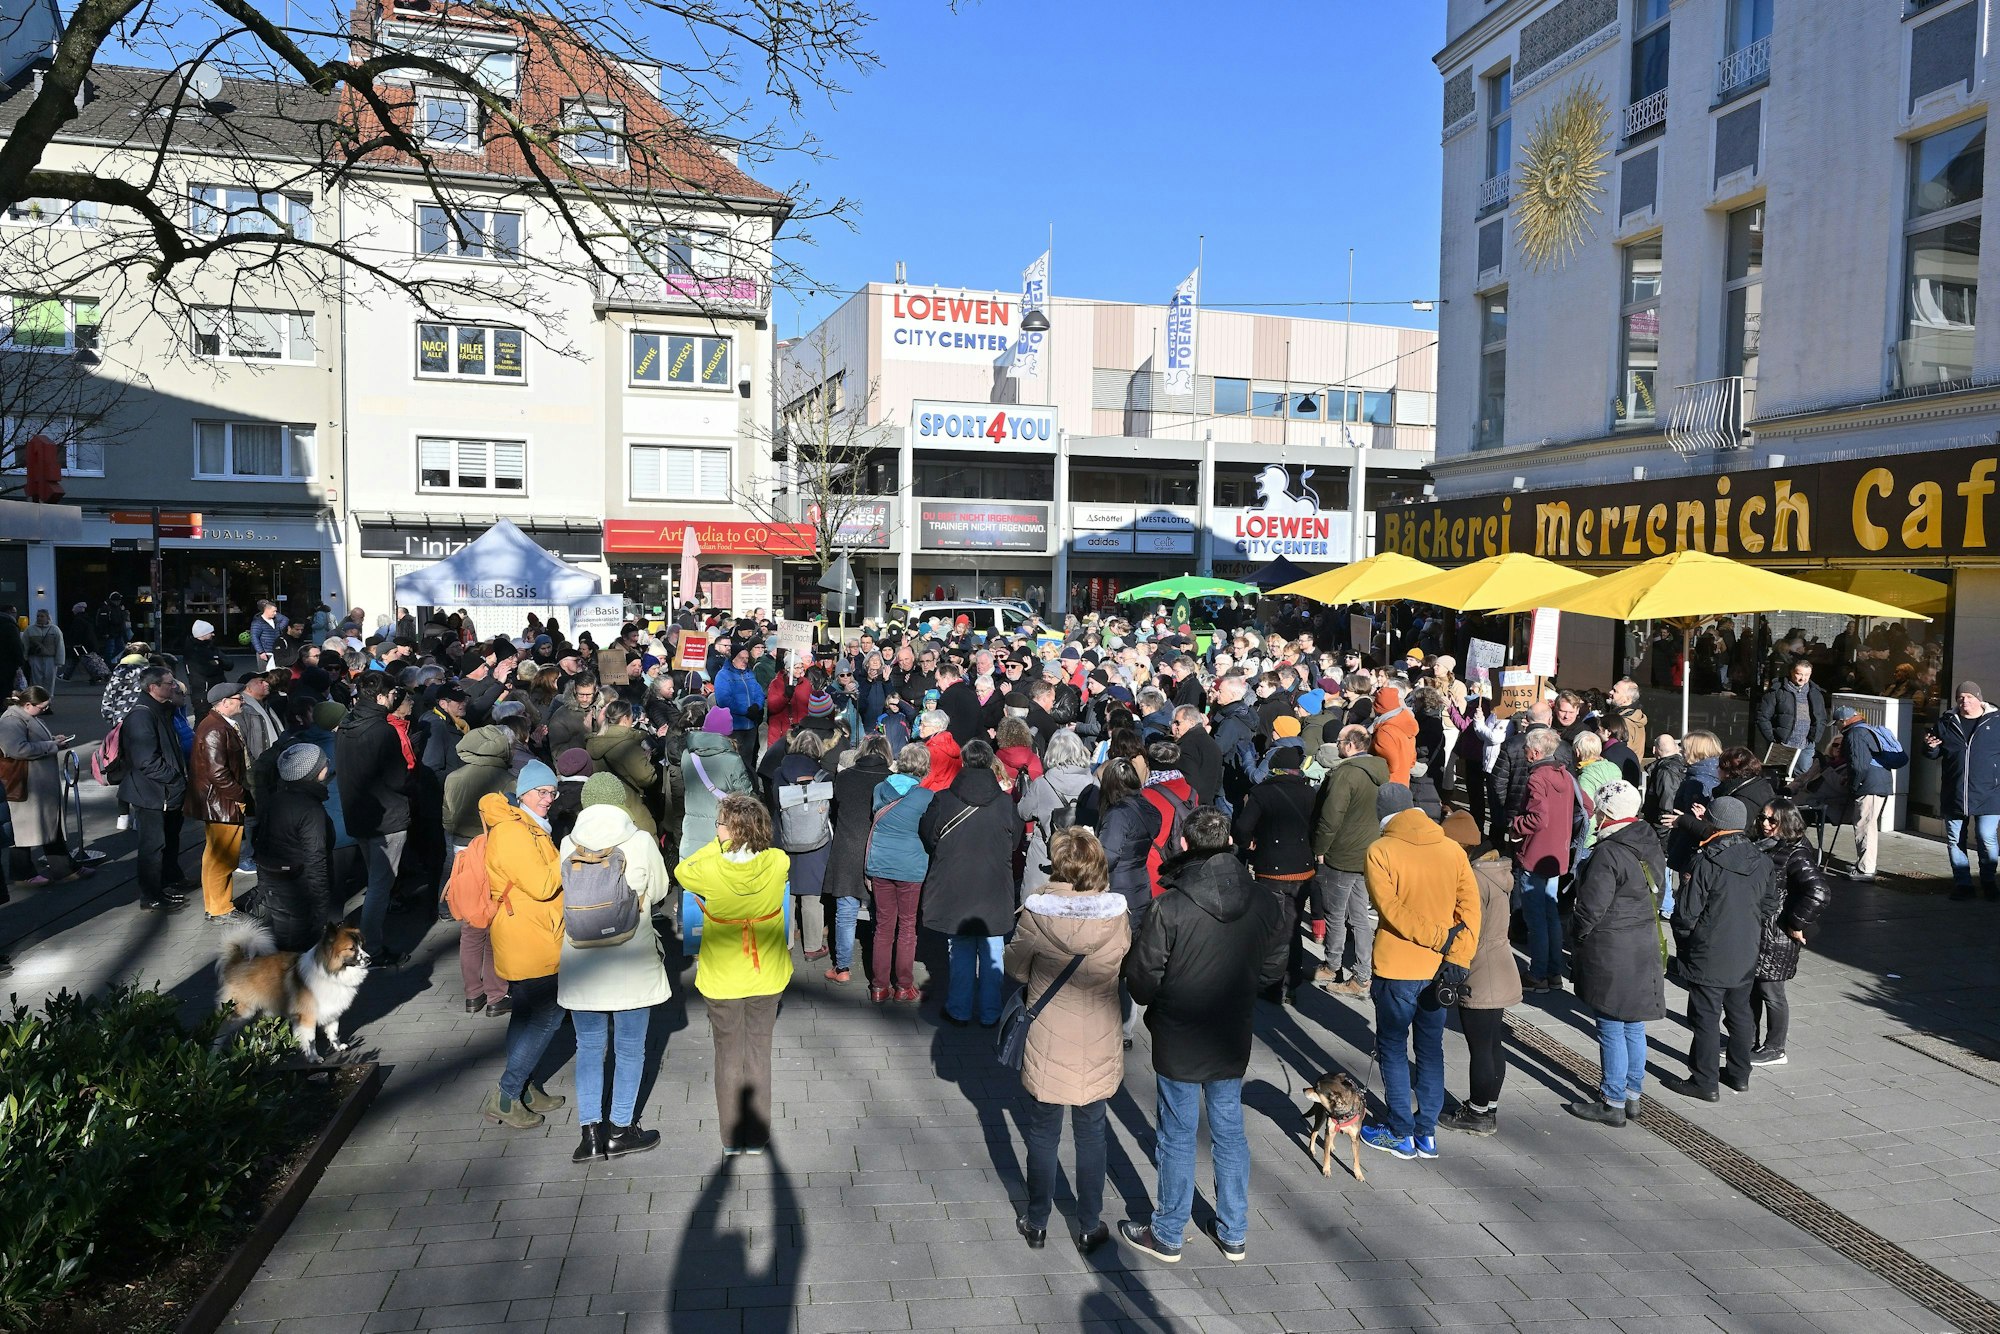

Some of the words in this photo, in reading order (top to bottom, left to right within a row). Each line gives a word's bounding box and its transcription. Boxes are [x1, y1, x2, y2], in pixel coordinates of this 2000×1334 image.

[894, 293, 1009, 326] LOEWEN
[422, 341, 447, 351] NACH
[460, 343, 483, 354] HILFE
[459, 352, 484, 361] FÄCHER
[636, 347, 658, 376] MATHE
[669, 343, 693, 379] DEUTSCH
[702, 343, 727, 380] ENGLISCH
[919, 411, 1051, 444] SPORT4YOU
[1852, 457, 1998, 551] Caf
[923, 511, 936, 521] DU
[938, 512, 957, 521] BIST
[960, 513, 986, 522] NICHT
[988, 513, 1040, 524] IRGENDWER.
[1094, 514, 1123, 522] Schöffel
[929, 521, 969, 531] TRAINIER
[971, 522, 997, 532] NICHT
[999, 523, 1046, 533] IRGENDWO.
[1235, 515, 1329, 539] LOEWEN
[1384, 496, 1512, 558] Bäckerei
[201, 529, 278, 541] TUALS...
[659, 526, 684, 542] Art
[692, 528, 726, 543] ndia
[727, 530, 741, 543] to
[744, 528, 768, 543] GO
[832, 534, 873, 544] NGANG
[697, 542, 716, 550] ndian
[717, 542, 732, 550] Food
[1087, 537, 1120, 546] adidas
[470, 584, 537, 598] dieBasis
[582, 606, 619, 616] dieBasis
[780, 632, 794, 641] lass
[795, 633, 812, 643] nach
[1504, 671, 1532, 684] MERZ
[1502, 688, 1533, 697] muss
